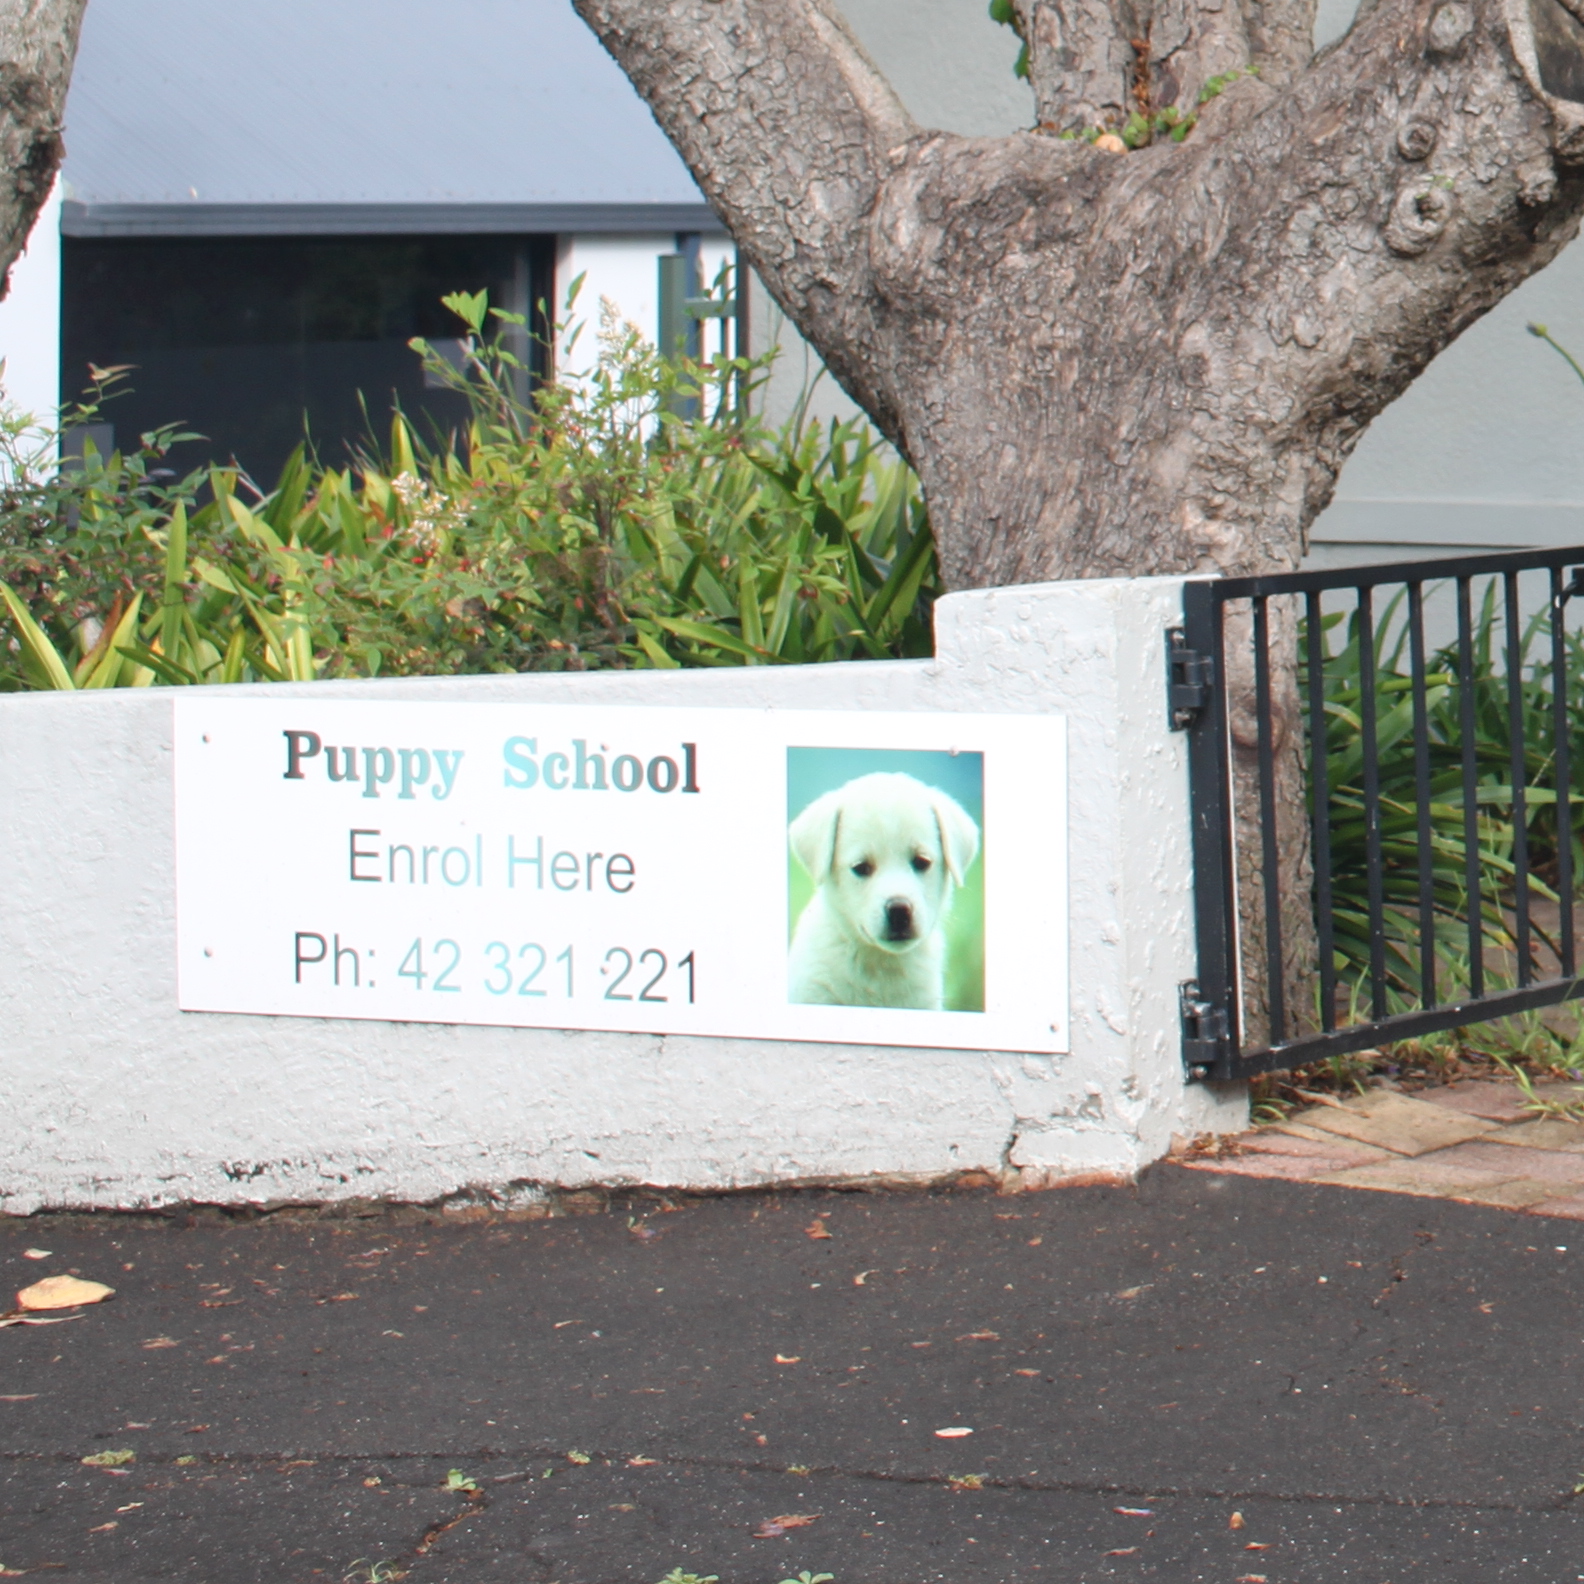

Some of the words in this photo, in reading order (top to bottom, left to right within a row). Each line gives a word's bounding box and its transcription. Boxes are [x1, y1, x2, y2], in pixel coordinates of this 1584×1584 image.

[281, 729, 465, 802] Puppy
[502, 735, 702, 796] School
[347, 829, 483, 888] Enrol
[507, 836, 637, 896] Here
[293, 931, 377, 990] Ph:
[397, 938, 462, 994] 42
[484, 941, 575, 999] 321
[602, 948, 697, 1006] 221
